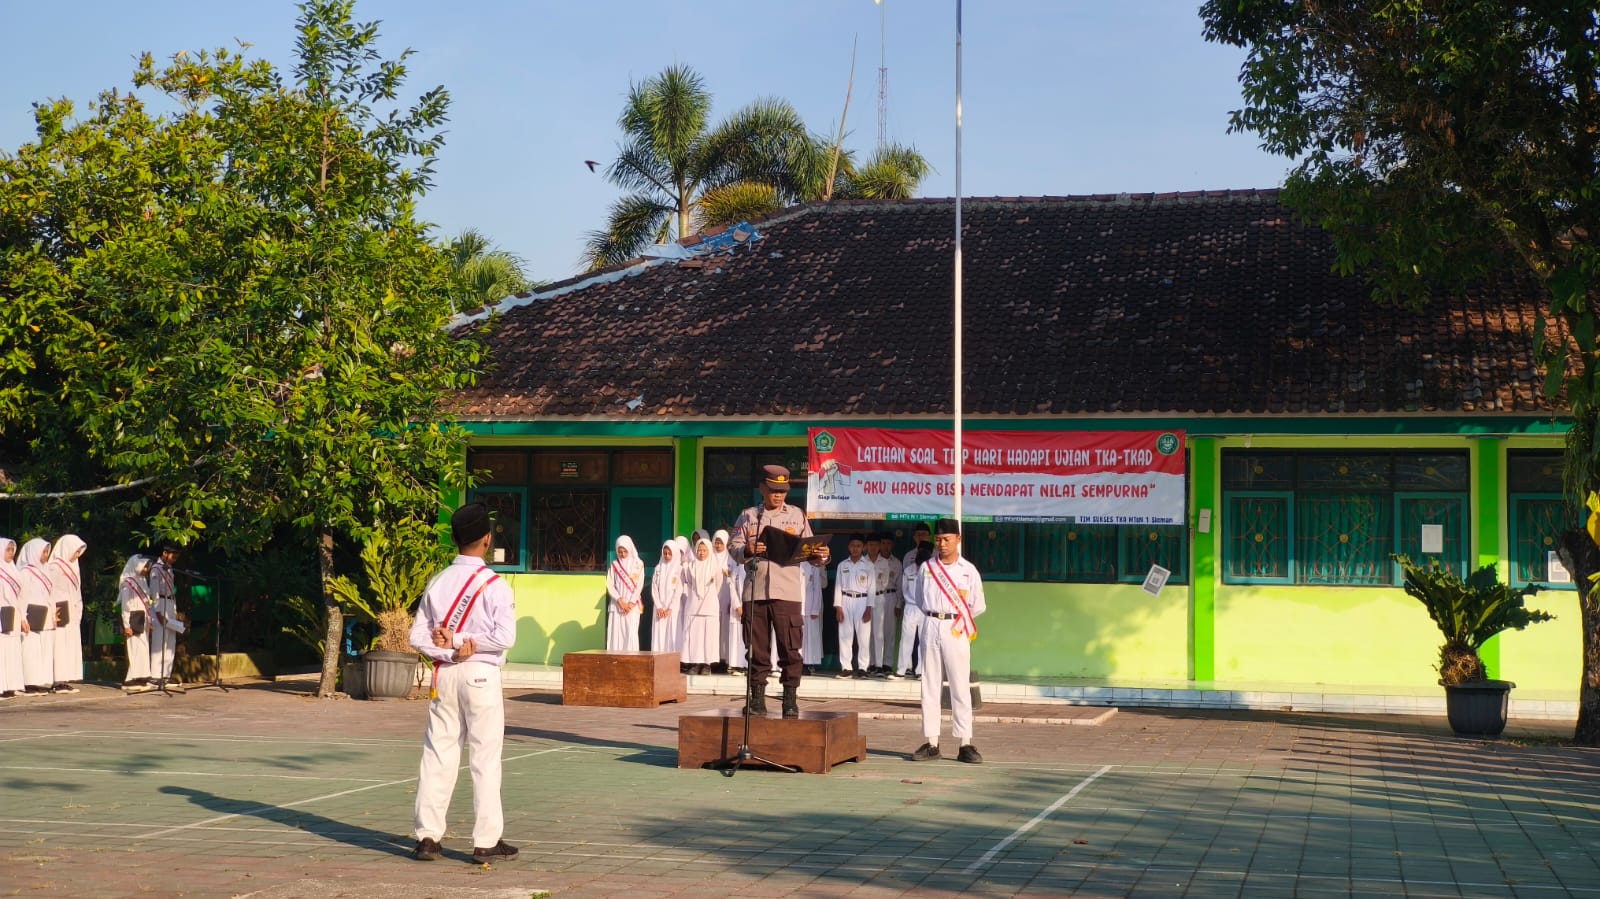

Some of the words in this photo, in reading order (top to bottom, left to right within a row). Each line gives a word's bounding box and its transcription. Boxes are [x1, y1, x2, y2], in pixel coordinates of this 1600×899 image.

[857, 446, 906, 463] LATIHAN
[910, 447, 938, 465] SOAL
[942, 447, 969, 465] TIP
[974, 448, 1003, 466] HARI
[1007, 449, 1051, 466] HADAPI
[1054, 449, 1090, 466] UJIAN
[1095, 449, 1153, 466] TKA-TKAD
[891, 481, 933, 495] HARUS
[970, 483, 1035, 497] MENDAPAT
[1040, 484, 1076, 498] NILAI
